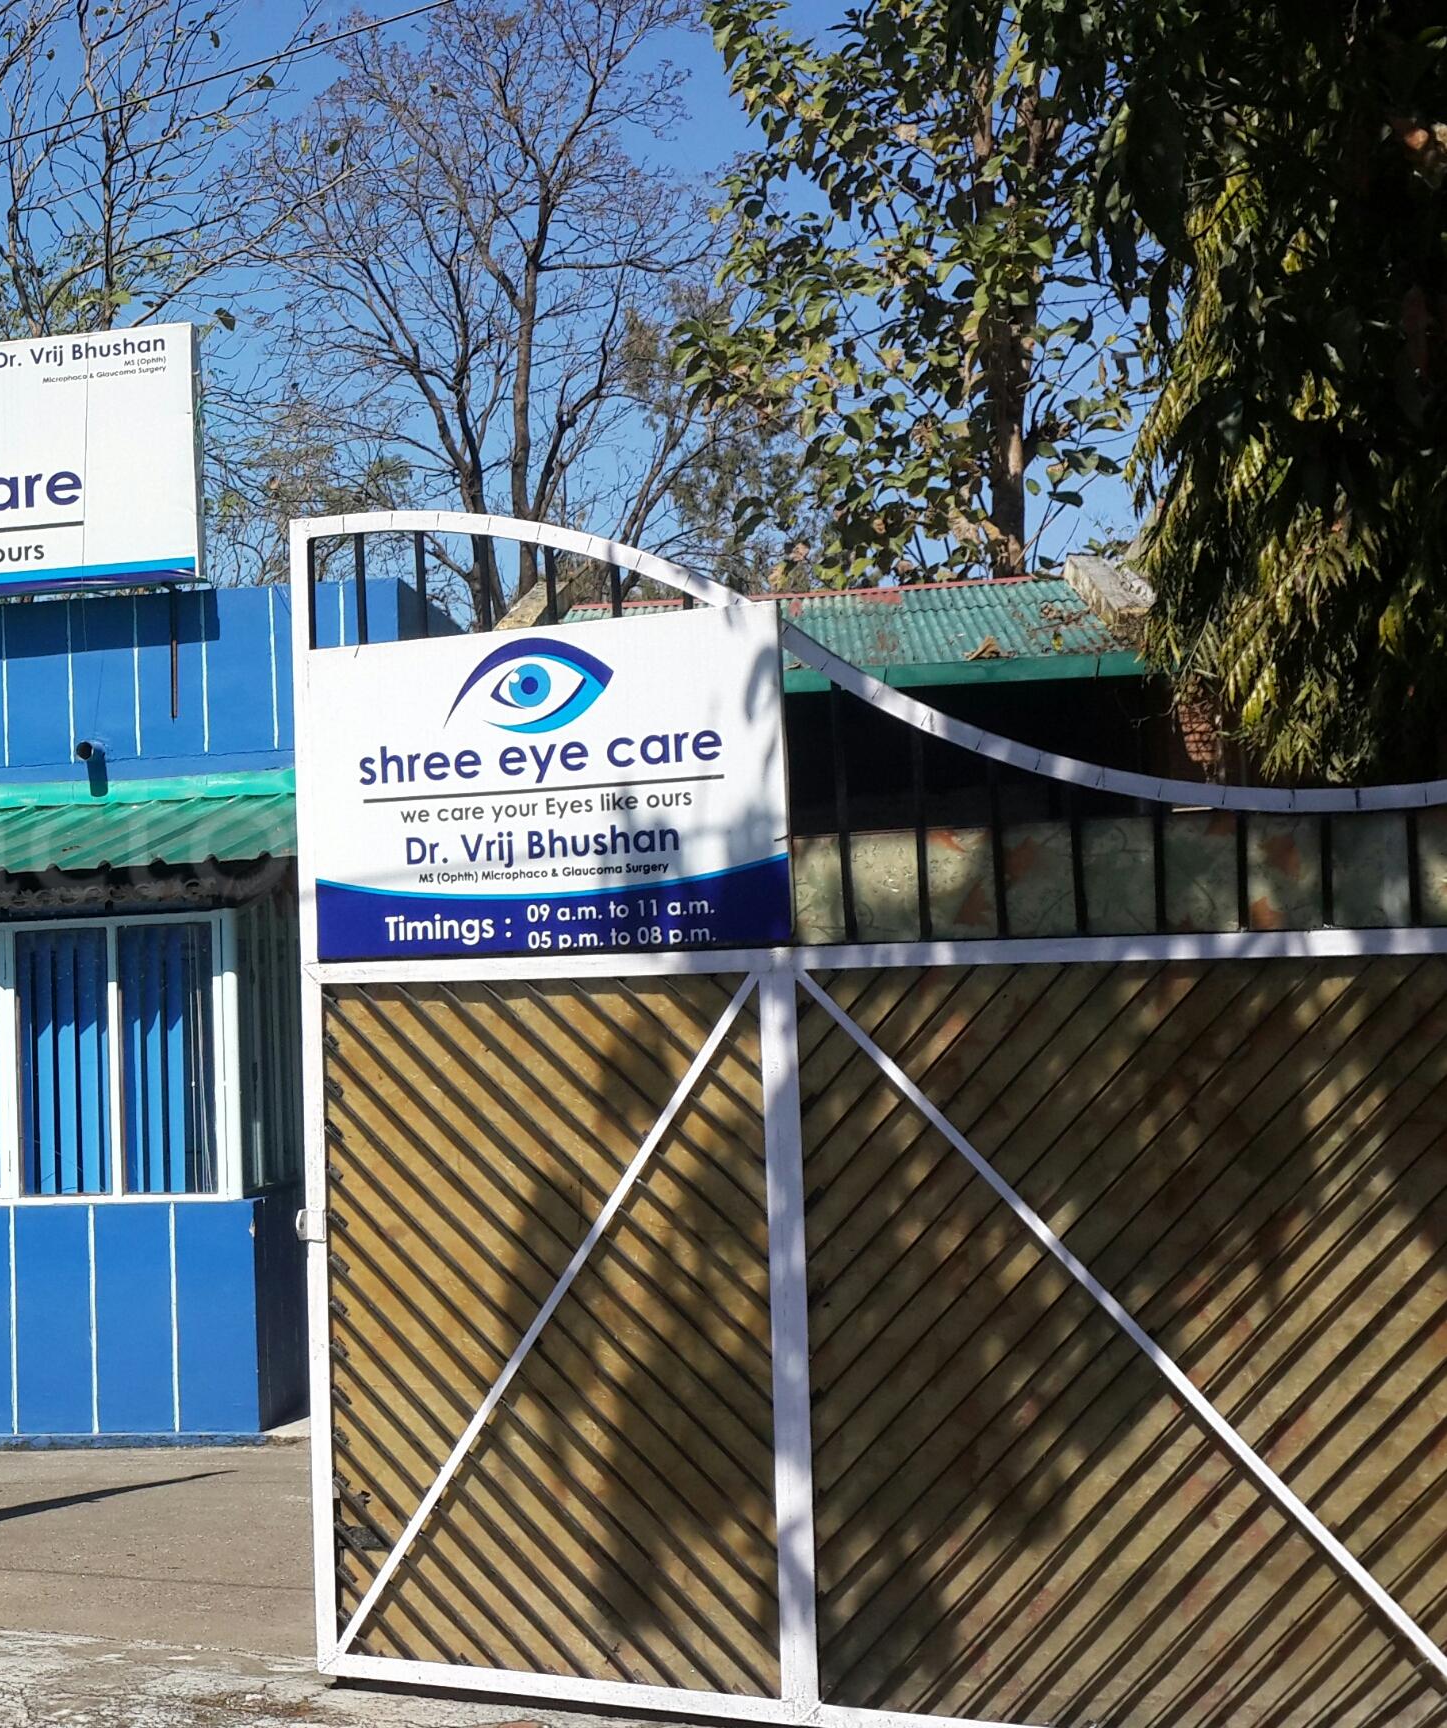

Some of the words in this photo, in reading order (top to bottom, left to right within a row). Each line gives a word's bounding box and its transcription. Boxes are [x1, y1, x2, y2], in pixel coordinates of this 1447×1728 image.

[30, 345, 64, 366] Vrij
[72, 338, 165, 360] Bhushan
[138, 365, 167, 375] Surgery
[359, 745, 482, 786] shree
[499, 740, 589, 784] eye
[607, 730, 724, 767] care
[401, 808, 430, 824] we
[437, 805, 484, 822] care
[492, 800, 538, 821] your
[546, 795, 594, 816] Eyes
[599, 791, 639, 812] like
[646, 790, 693, 808] ours
[406, 837, 448, 865] Dr.
[461, 831, 515, 867] Vrij
[528, 825, 680, 860] Bhushan
[418, 873, 434, 884] MS
[436, 869, 478, 884] (Ophth)
[481, 868, 548, 883] Microphaco
[550, 867, 559, 878] &
[562, 865, 622, 878] Glaucoma
[626, 861, 669, 877] Surgery
[526, 904, 551, 923] 09
[557, 905, 603, 921] a.m.
[608, 901, 630, 918] to
[636, 899, 658, 917] 11
[667, 898, 715, 916] a.m.
[384, 913, 495, 946] Timings
[527, 931, 552, 949] 05
[558, 931, 604, 950] p.m.
[610, 929, 631, 945] to
[637, 927, 662, 944] 08
[668, 927, 716, 945] p.m.
